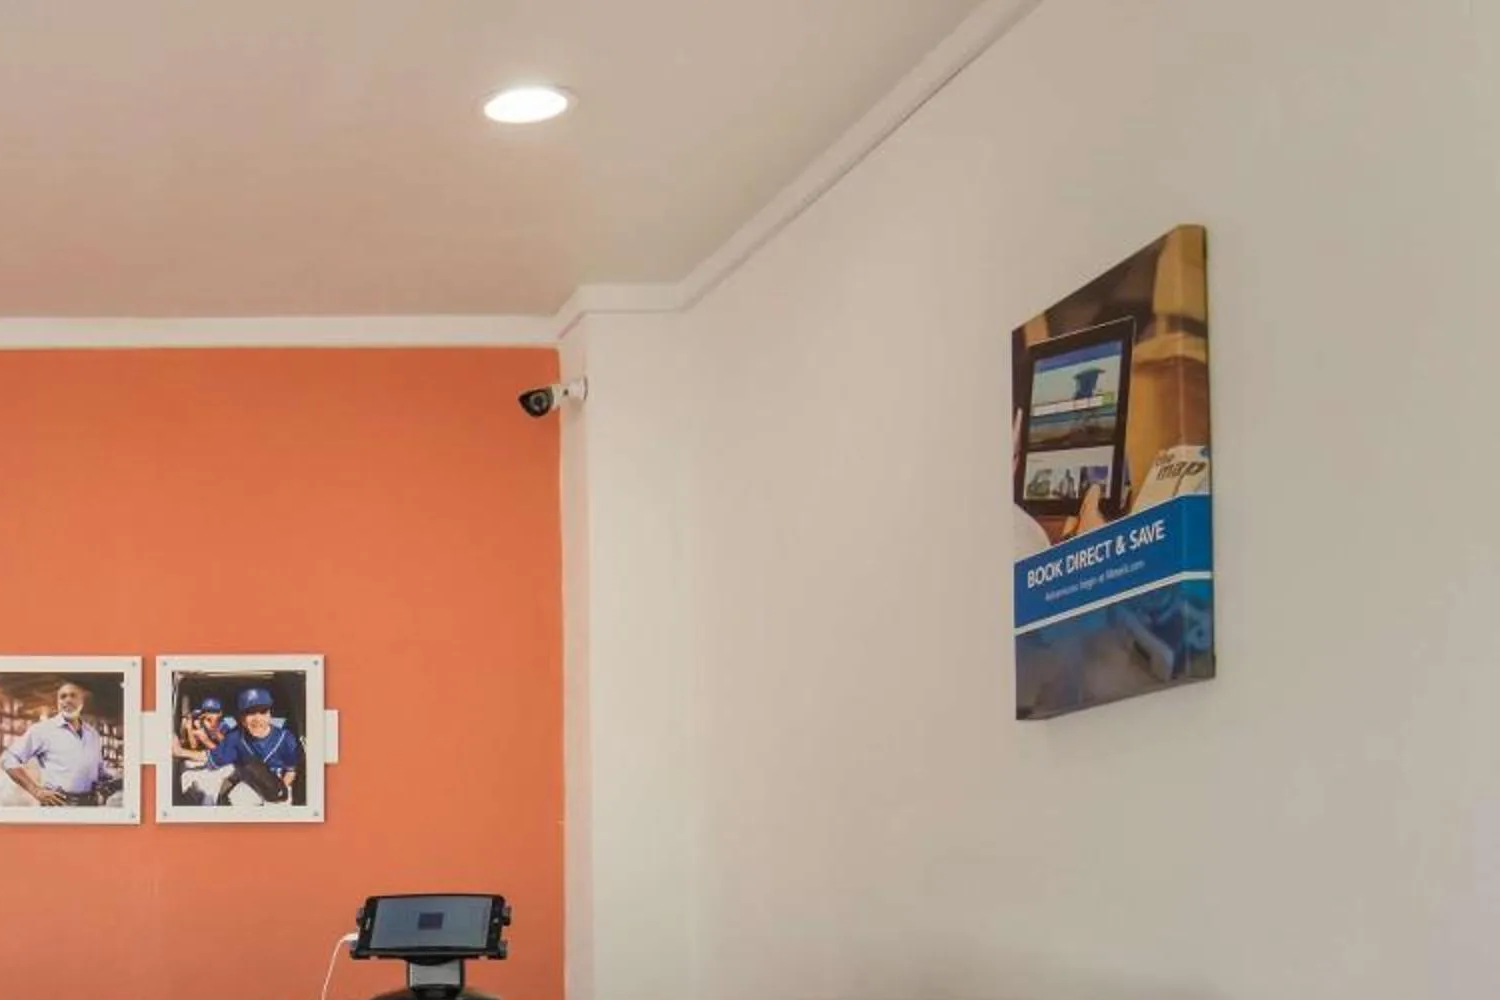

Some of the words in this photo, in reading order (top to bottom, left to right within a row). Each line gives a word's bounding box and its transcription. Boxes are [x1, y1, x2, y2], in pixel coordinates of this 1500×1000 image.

[1027, 559, 1063, 589] BOOK
[1066, 539, 1113, 574] DIRECT
[1116, 534, 1126, 556] &
[1129, 518, 1166, 550] SAVE
